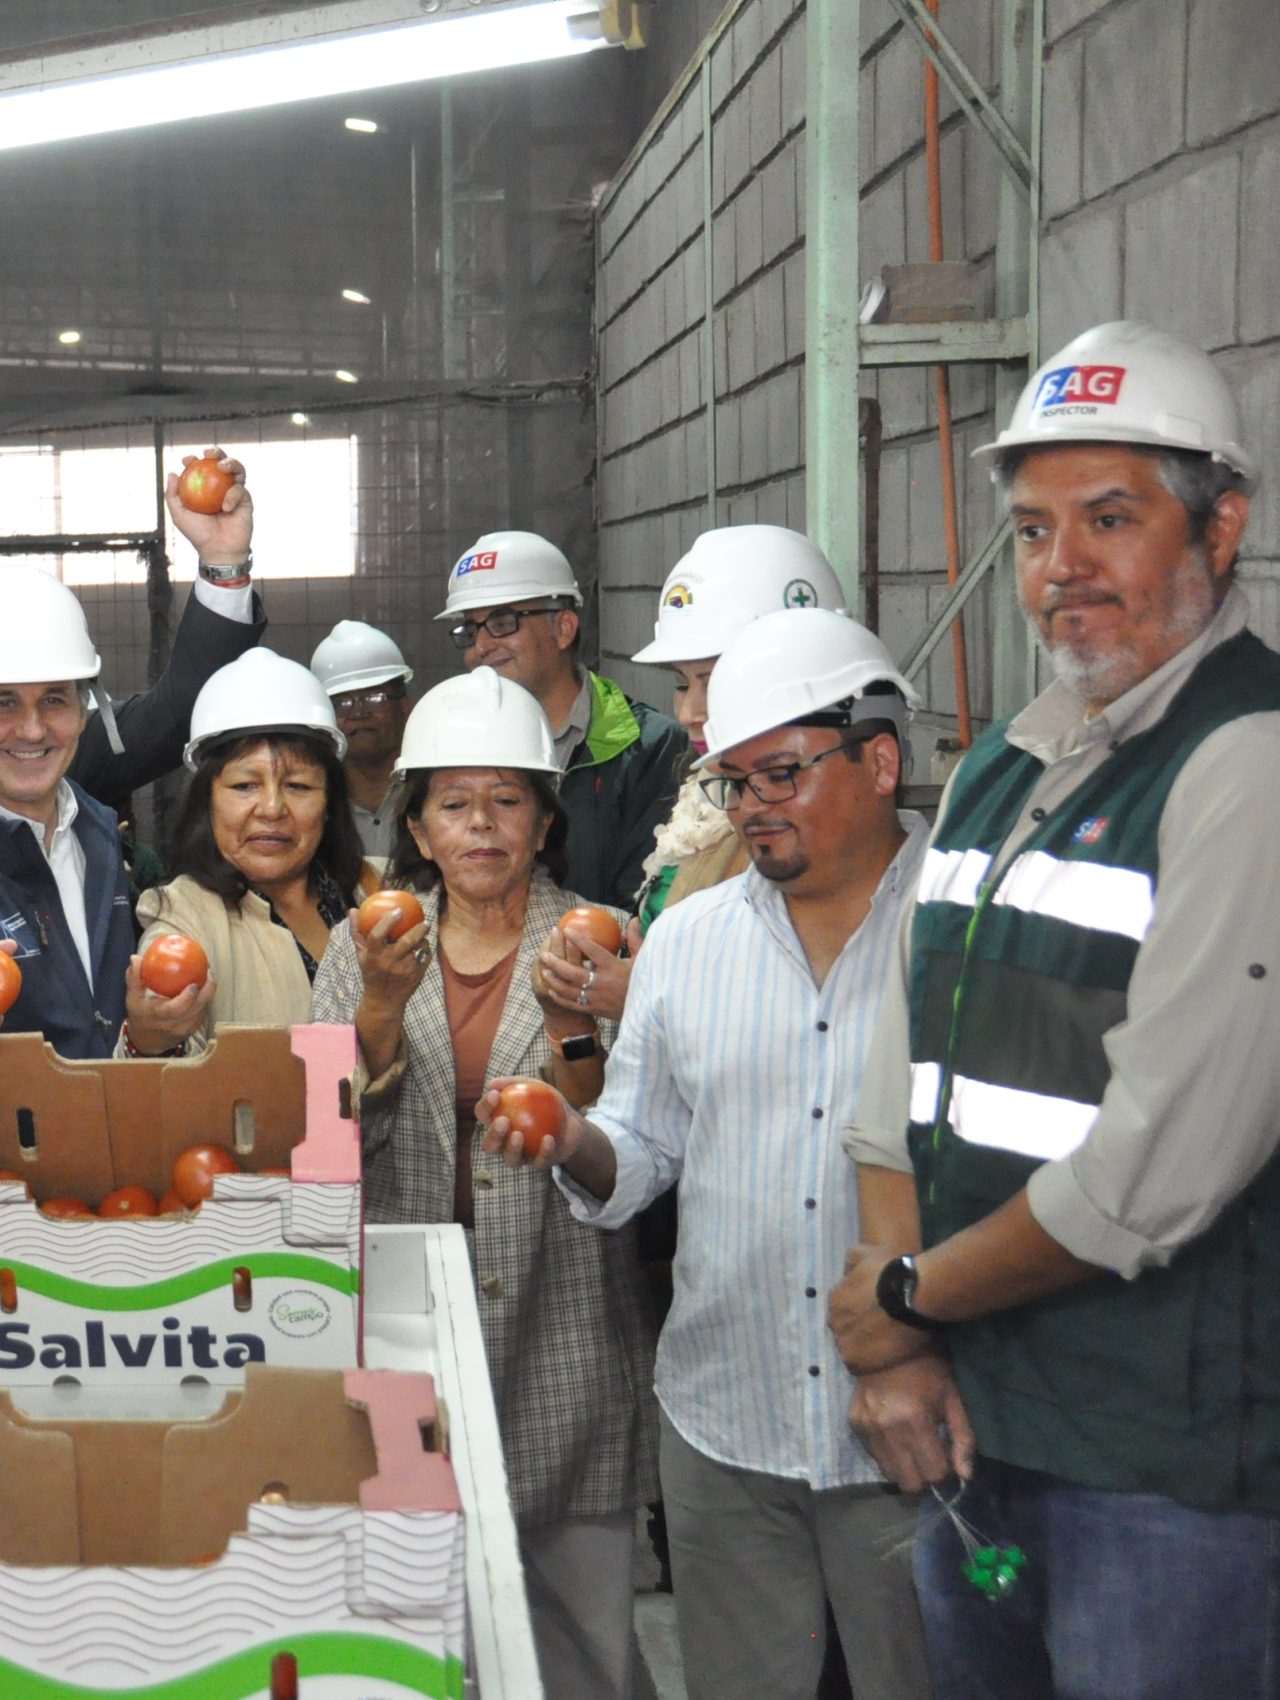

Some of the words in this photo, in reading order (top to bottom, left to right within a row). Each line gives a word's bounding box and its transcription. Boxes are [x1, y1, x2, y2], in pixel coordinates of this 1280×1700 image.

[1041, 371, 1116, 400] SAG
[1041, 405, 1098, 418] NSPECTOR
[459, 553, 494, 574] SAG
